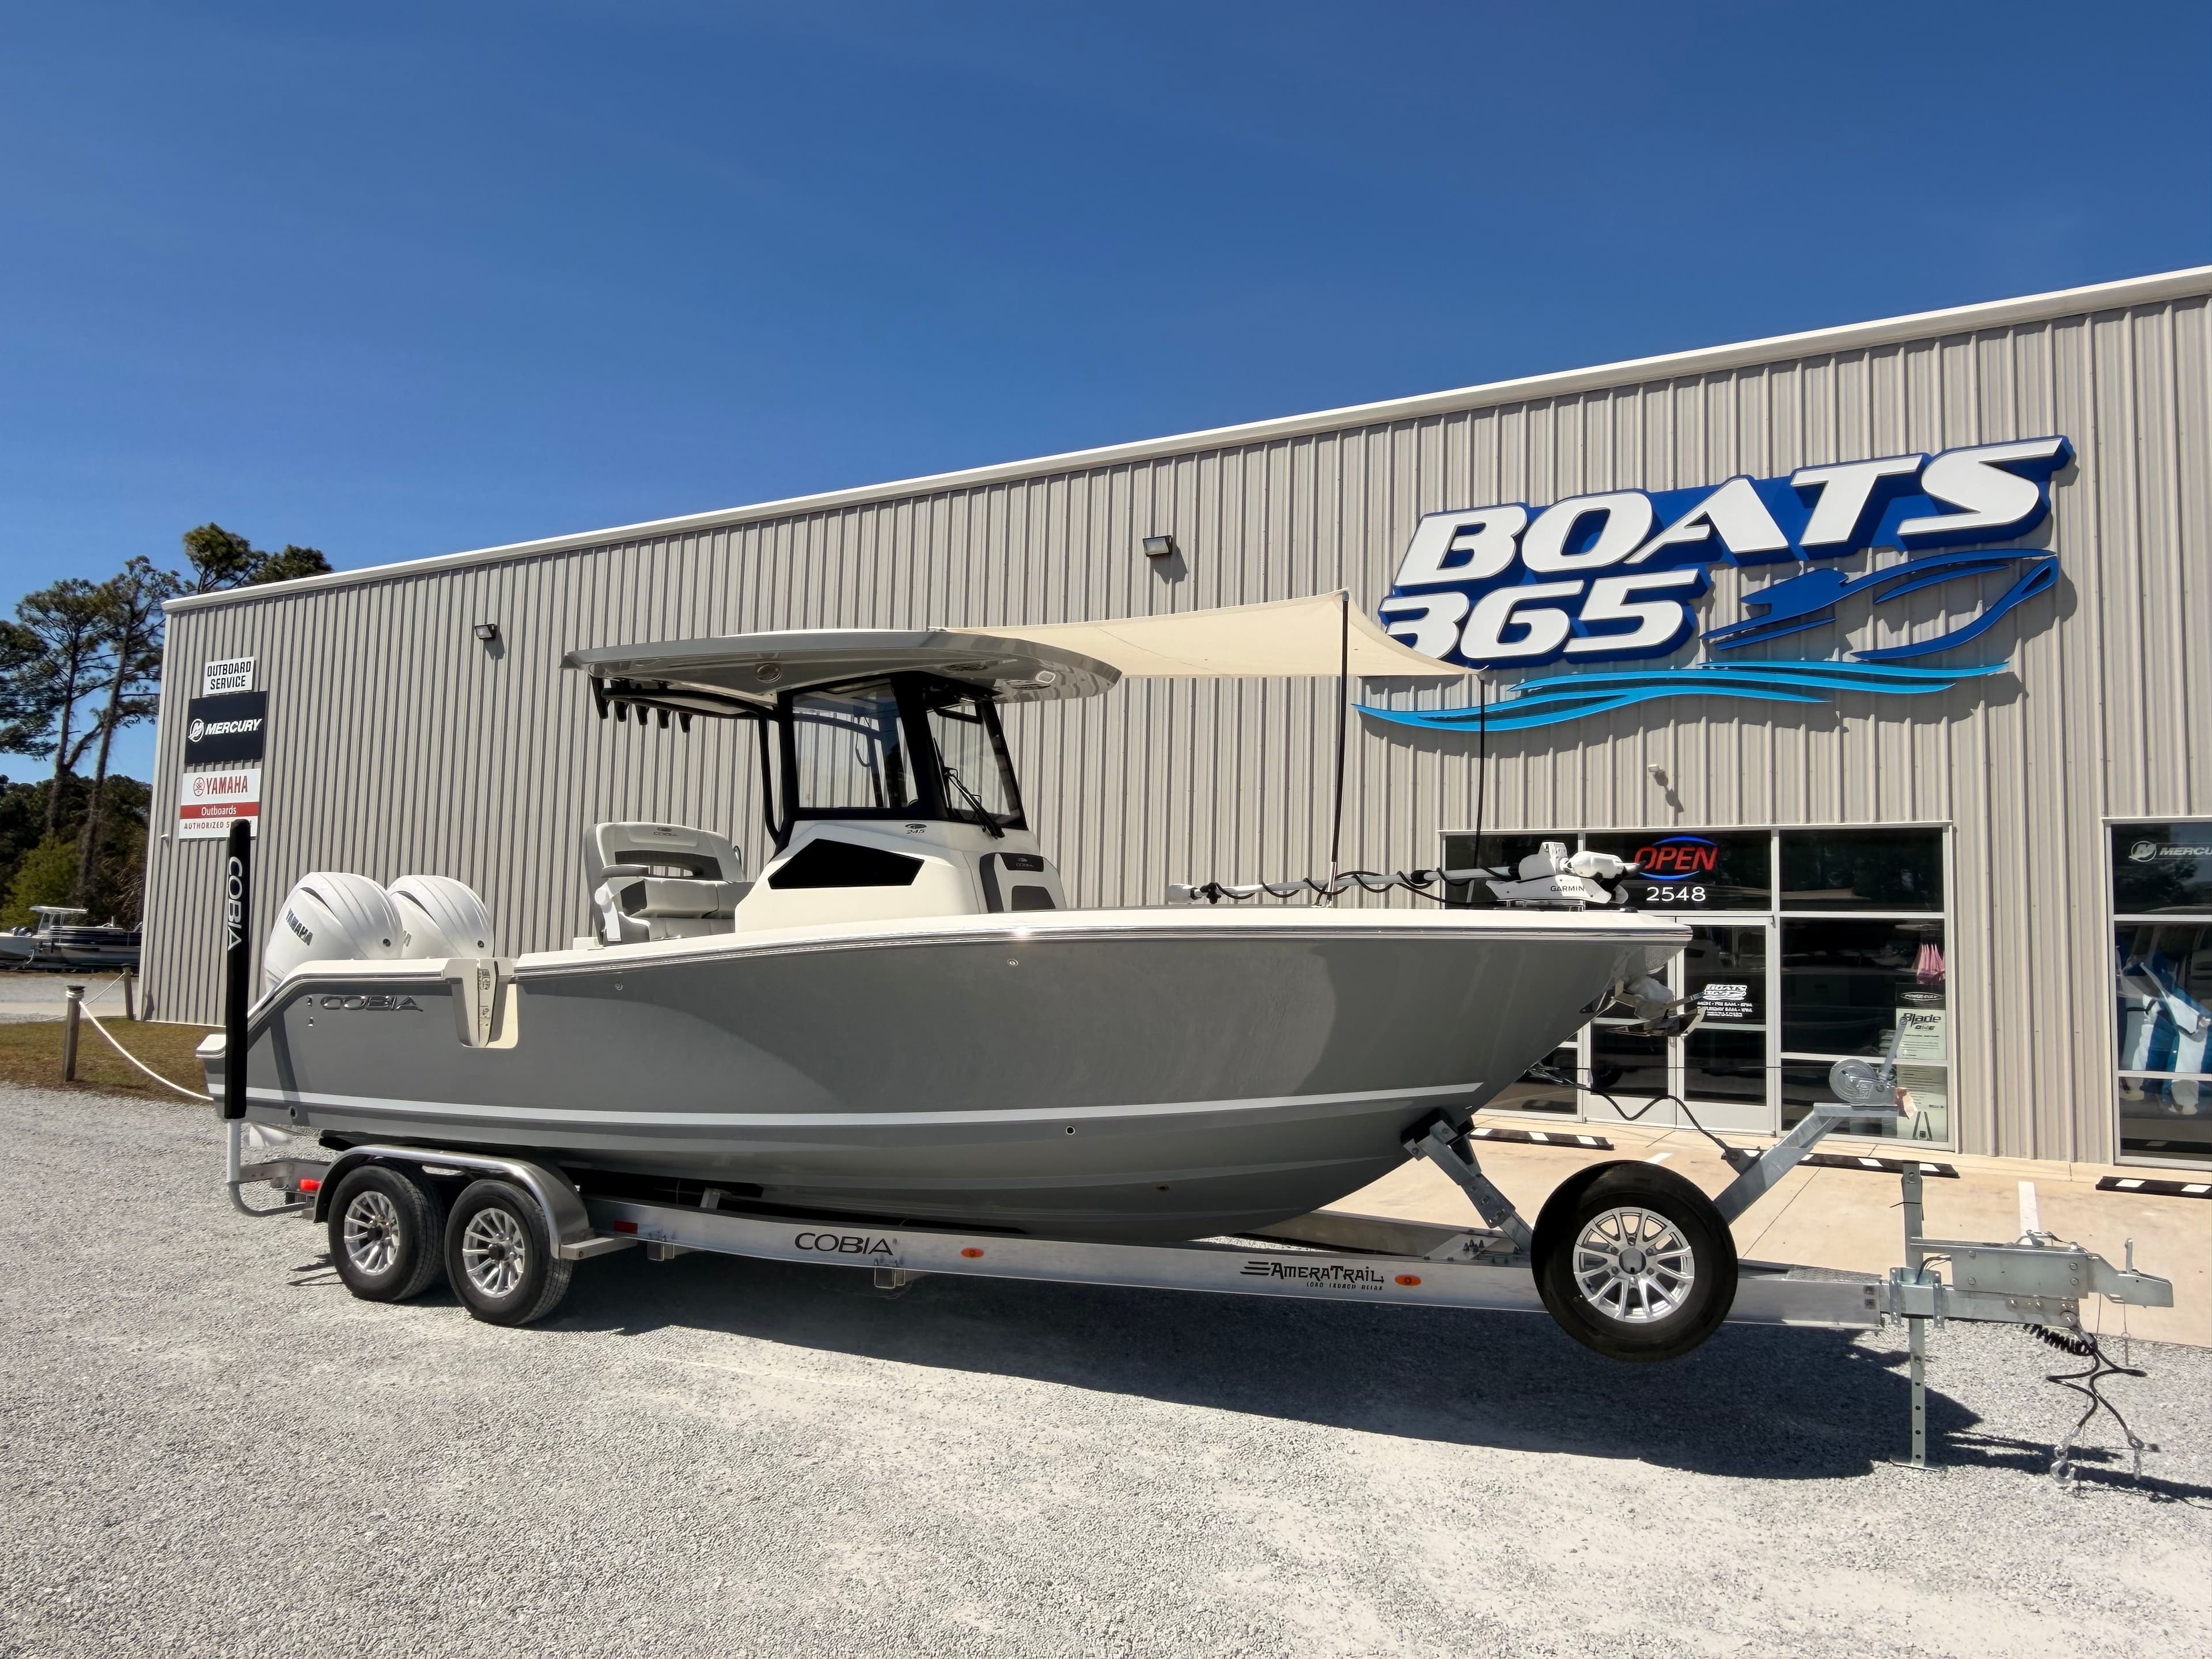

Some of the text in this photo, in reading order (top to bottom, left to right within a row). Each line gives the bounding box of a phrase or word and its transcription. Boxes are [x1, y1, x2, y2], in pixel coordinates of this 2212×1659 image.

[1393, 437, 2065, 588] BOATS
[1380, 569, 1699, 660] 365
[207, 661, 251, 677] OUTBOARD
[210, 676, 246, 690] SERVICE
[205, 718, 263, 736] MERCURY
[206, 775, 248, 795] YAMAHA
[201, 806, 237, 816] Outboards
[184, 821, 224, 830] AUTHORIZED
[1634, 846, 1719, 871] OPEN
[1646, 886, 1706, 902] 2548
[228, 856, 243, 951] COBIA
[286, 907, 313, 946] YAMAHA
[320, 995, 423, 1012] COBIA
[1903, 1013, 1941, 1028] Blade
[794, 1232, 893, 1256] COBIA
